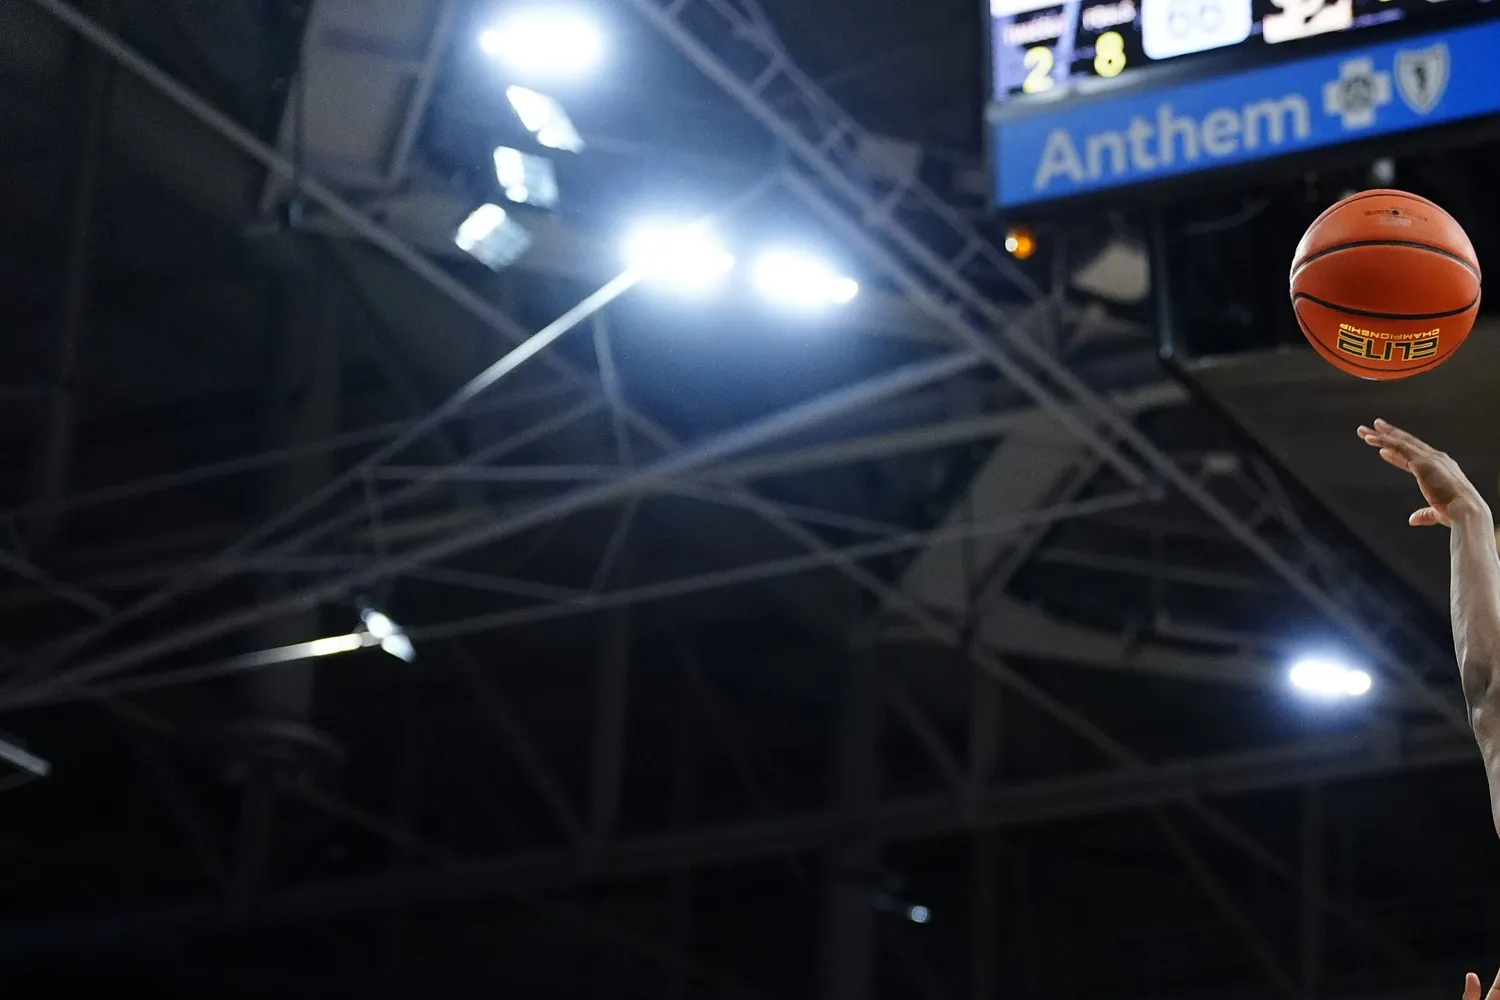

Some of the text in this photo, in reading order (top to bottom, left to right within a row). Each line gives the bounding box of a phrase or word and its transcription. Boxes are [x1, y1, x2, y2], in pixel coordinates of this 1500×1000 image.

[1023, 46, 1054, 93] 2
[1094, 31, 1126, 77] 8
[1036, 94, 1310, 190] Anthem
[1337, 329, 1439, 361] ELITE
[1339, 323, 1440, 340] CHAMPIONSHIP
